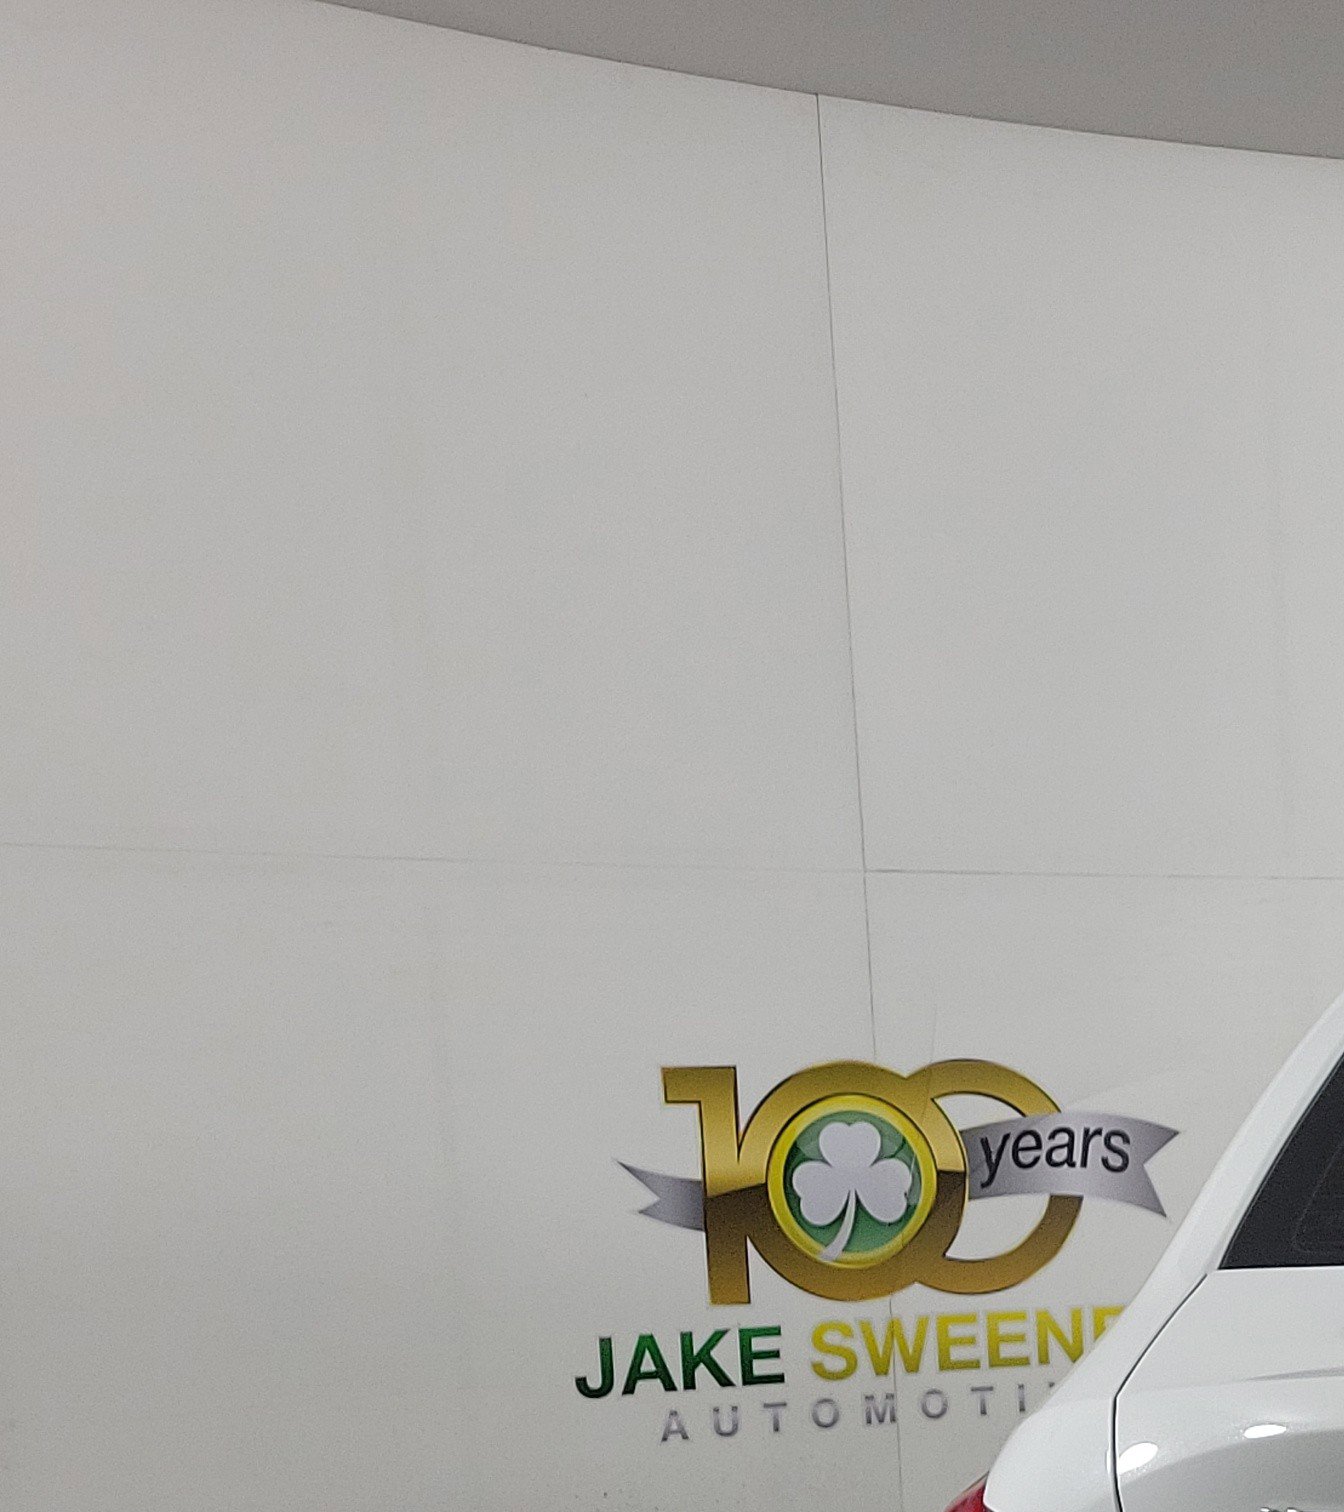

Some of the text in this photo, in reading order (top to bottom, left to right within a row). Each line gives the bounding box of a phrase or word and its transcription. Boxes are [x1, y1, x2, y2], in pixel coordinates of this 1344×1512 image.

[661, 1058, 1084, 1304] 100
[980, 1125, 1131, 1188] years
[575, 1326, 786, 1399] JAKE
[660, 1382, 1055, 1443] AUTOMOTI
